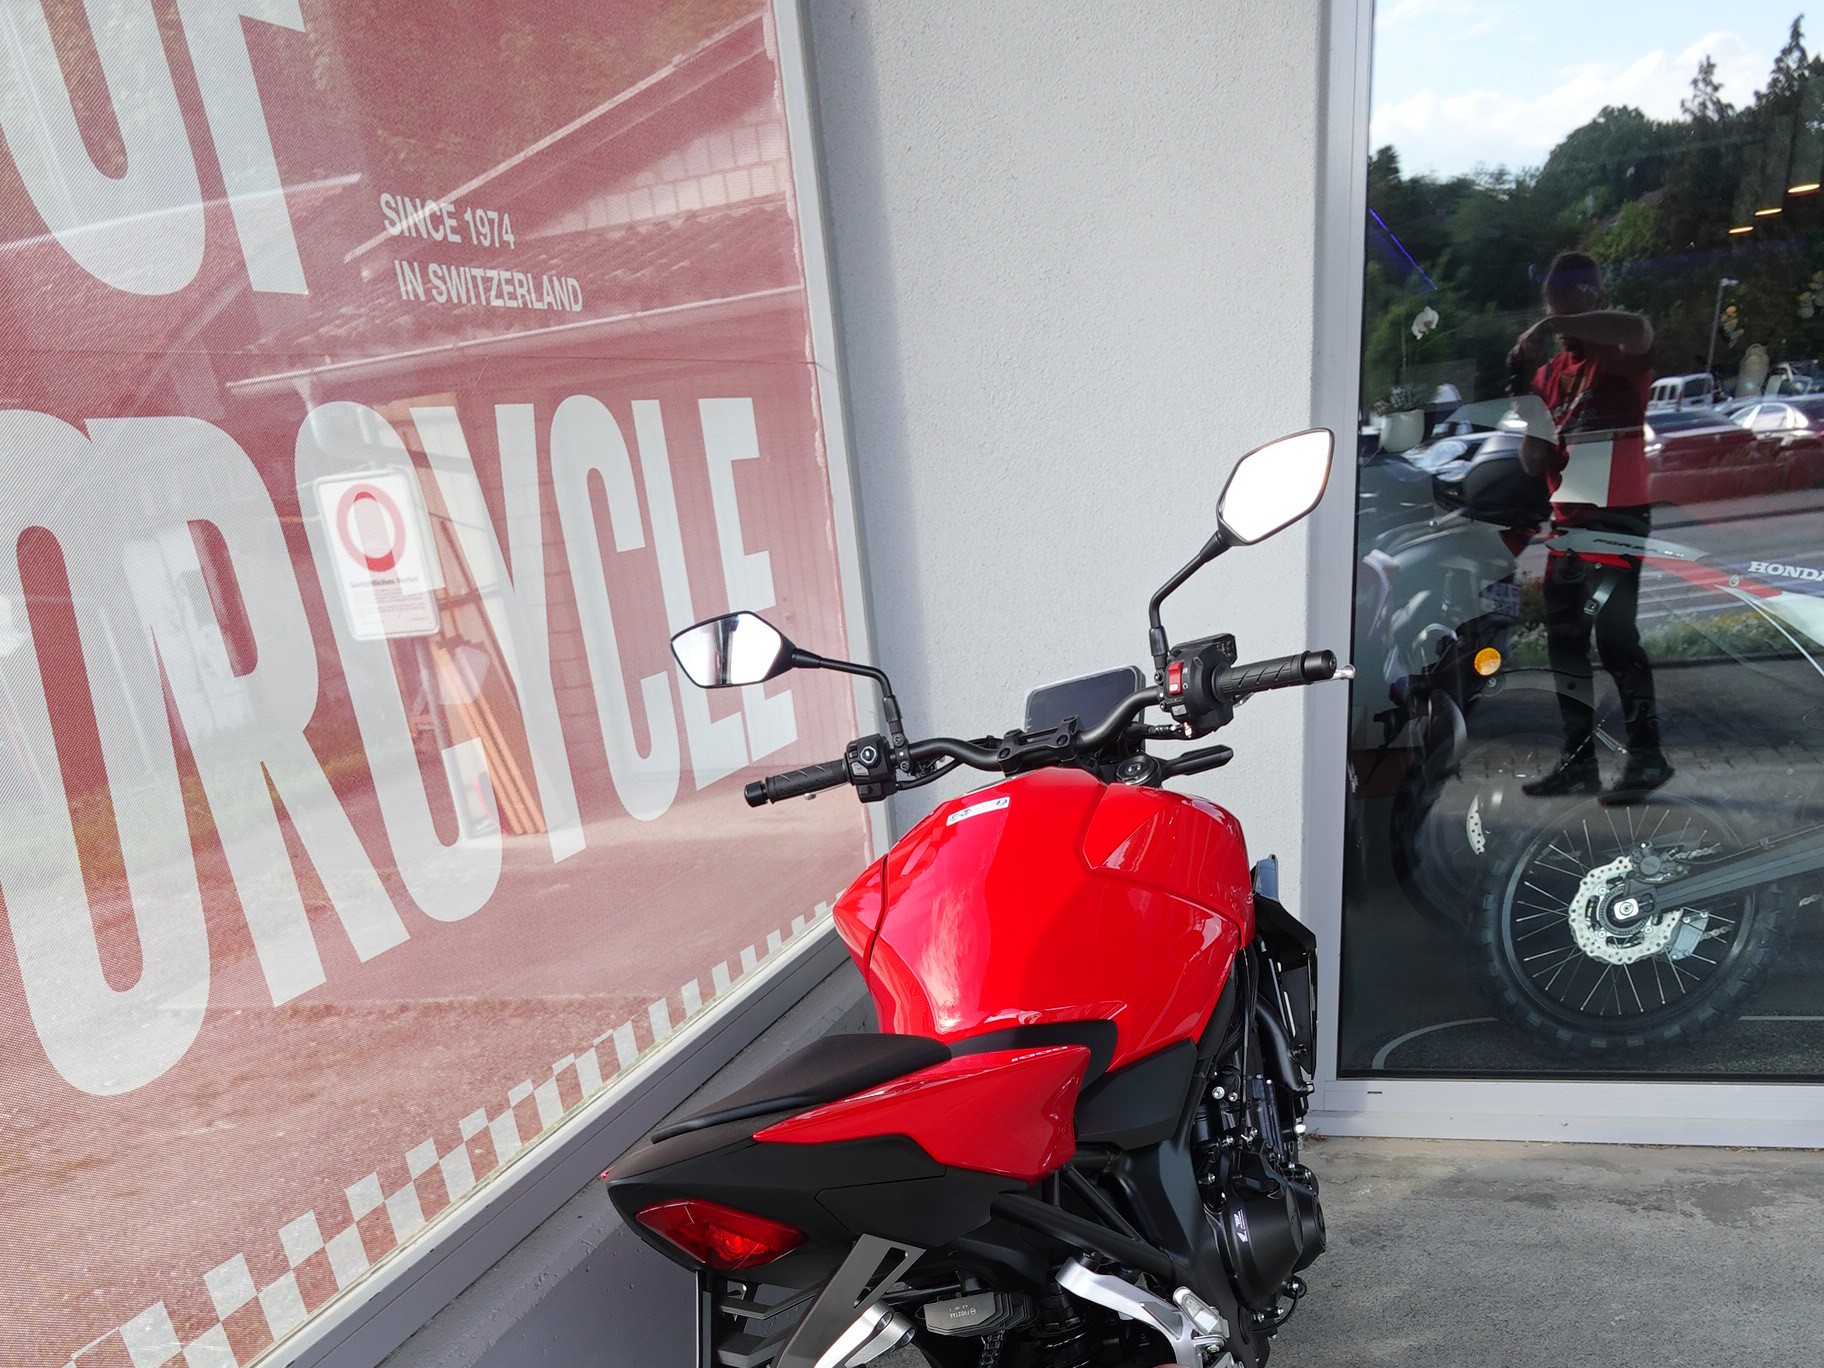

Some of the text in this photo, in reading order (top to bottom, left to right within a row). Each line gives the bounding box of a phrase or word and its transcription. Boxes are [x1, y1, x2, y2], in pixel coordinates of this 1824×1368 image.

[380, 192, 515, 249] SINCE 1974
[394, 260, 583, 312] IN SWITZERLAND
